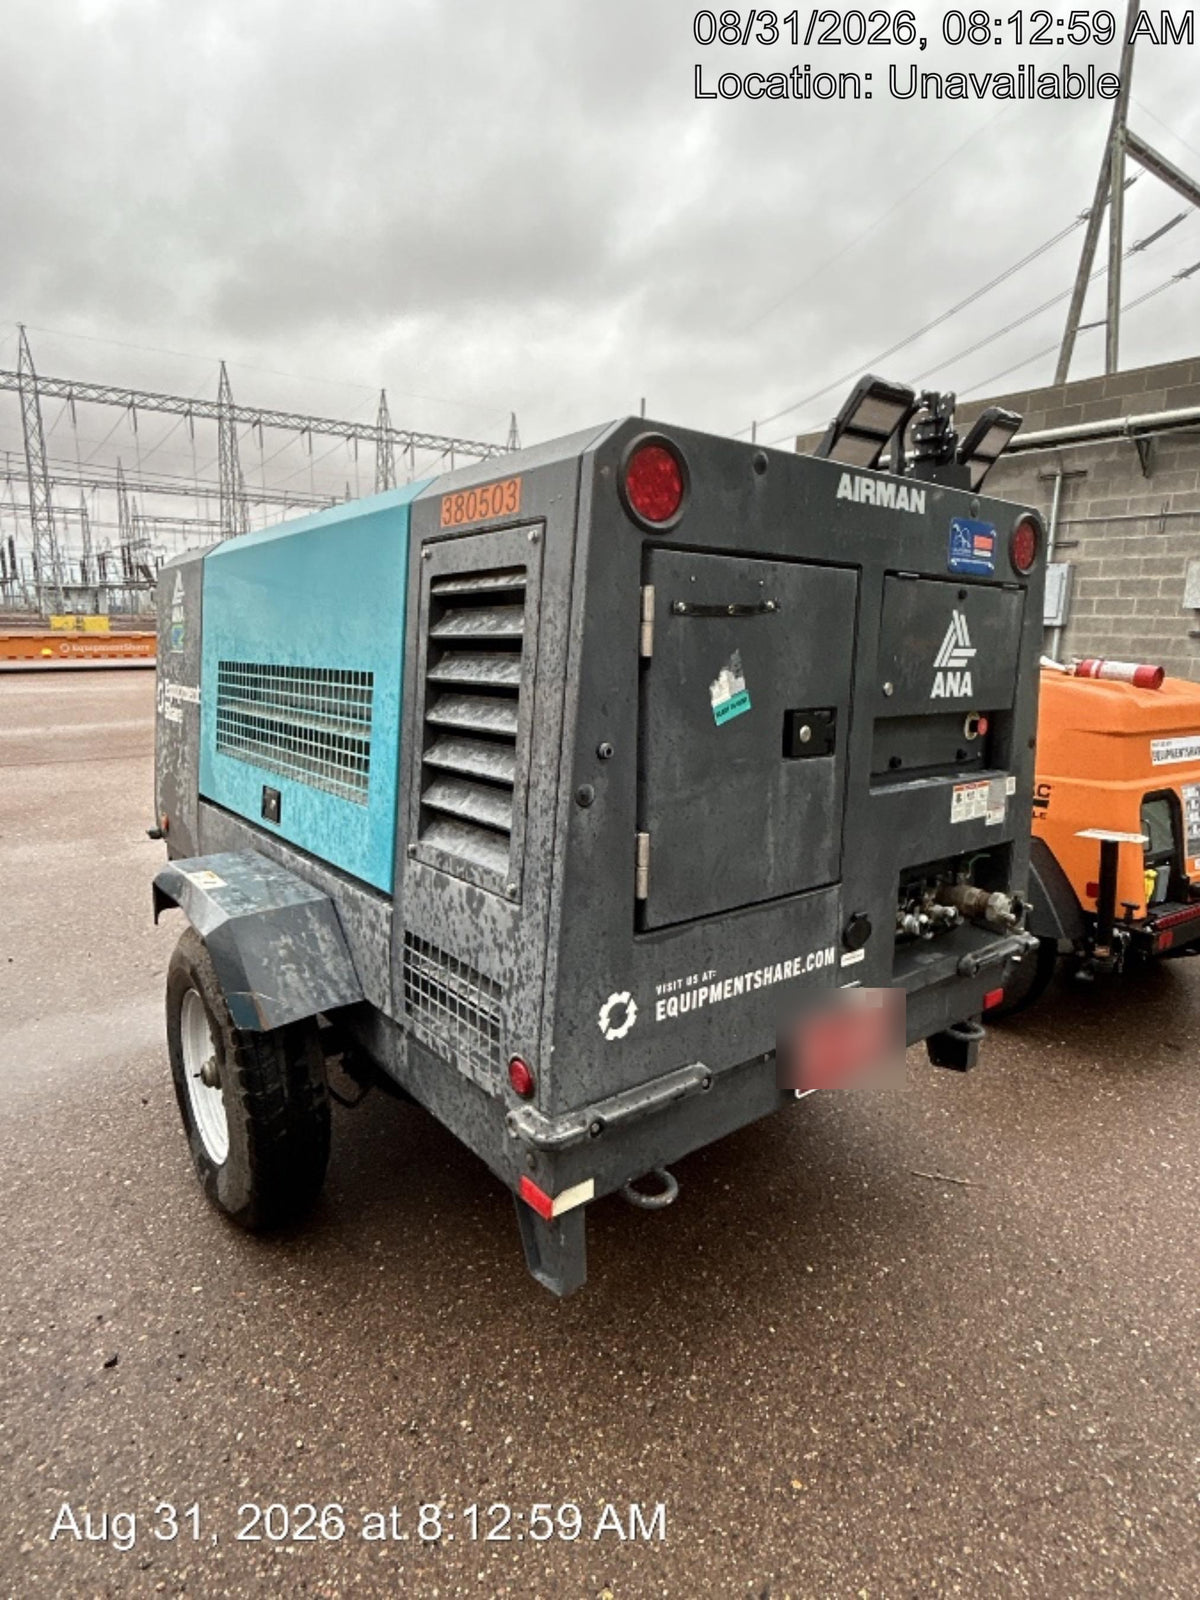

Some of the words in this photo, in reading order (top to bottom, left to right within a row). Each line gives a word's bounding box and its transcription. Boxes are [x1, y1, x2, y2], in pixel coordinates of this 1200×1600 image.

[442, 479, 519, 526] 380503
[836, 472, 927, 515] AIRMAN
[930, 671, 974, 699] ANA
[655, 946, 835, 1022] EQUIPMENTSHARE.COM
[655, 978, 683, 996] VISIT
[686, 973, 699, 986] US
